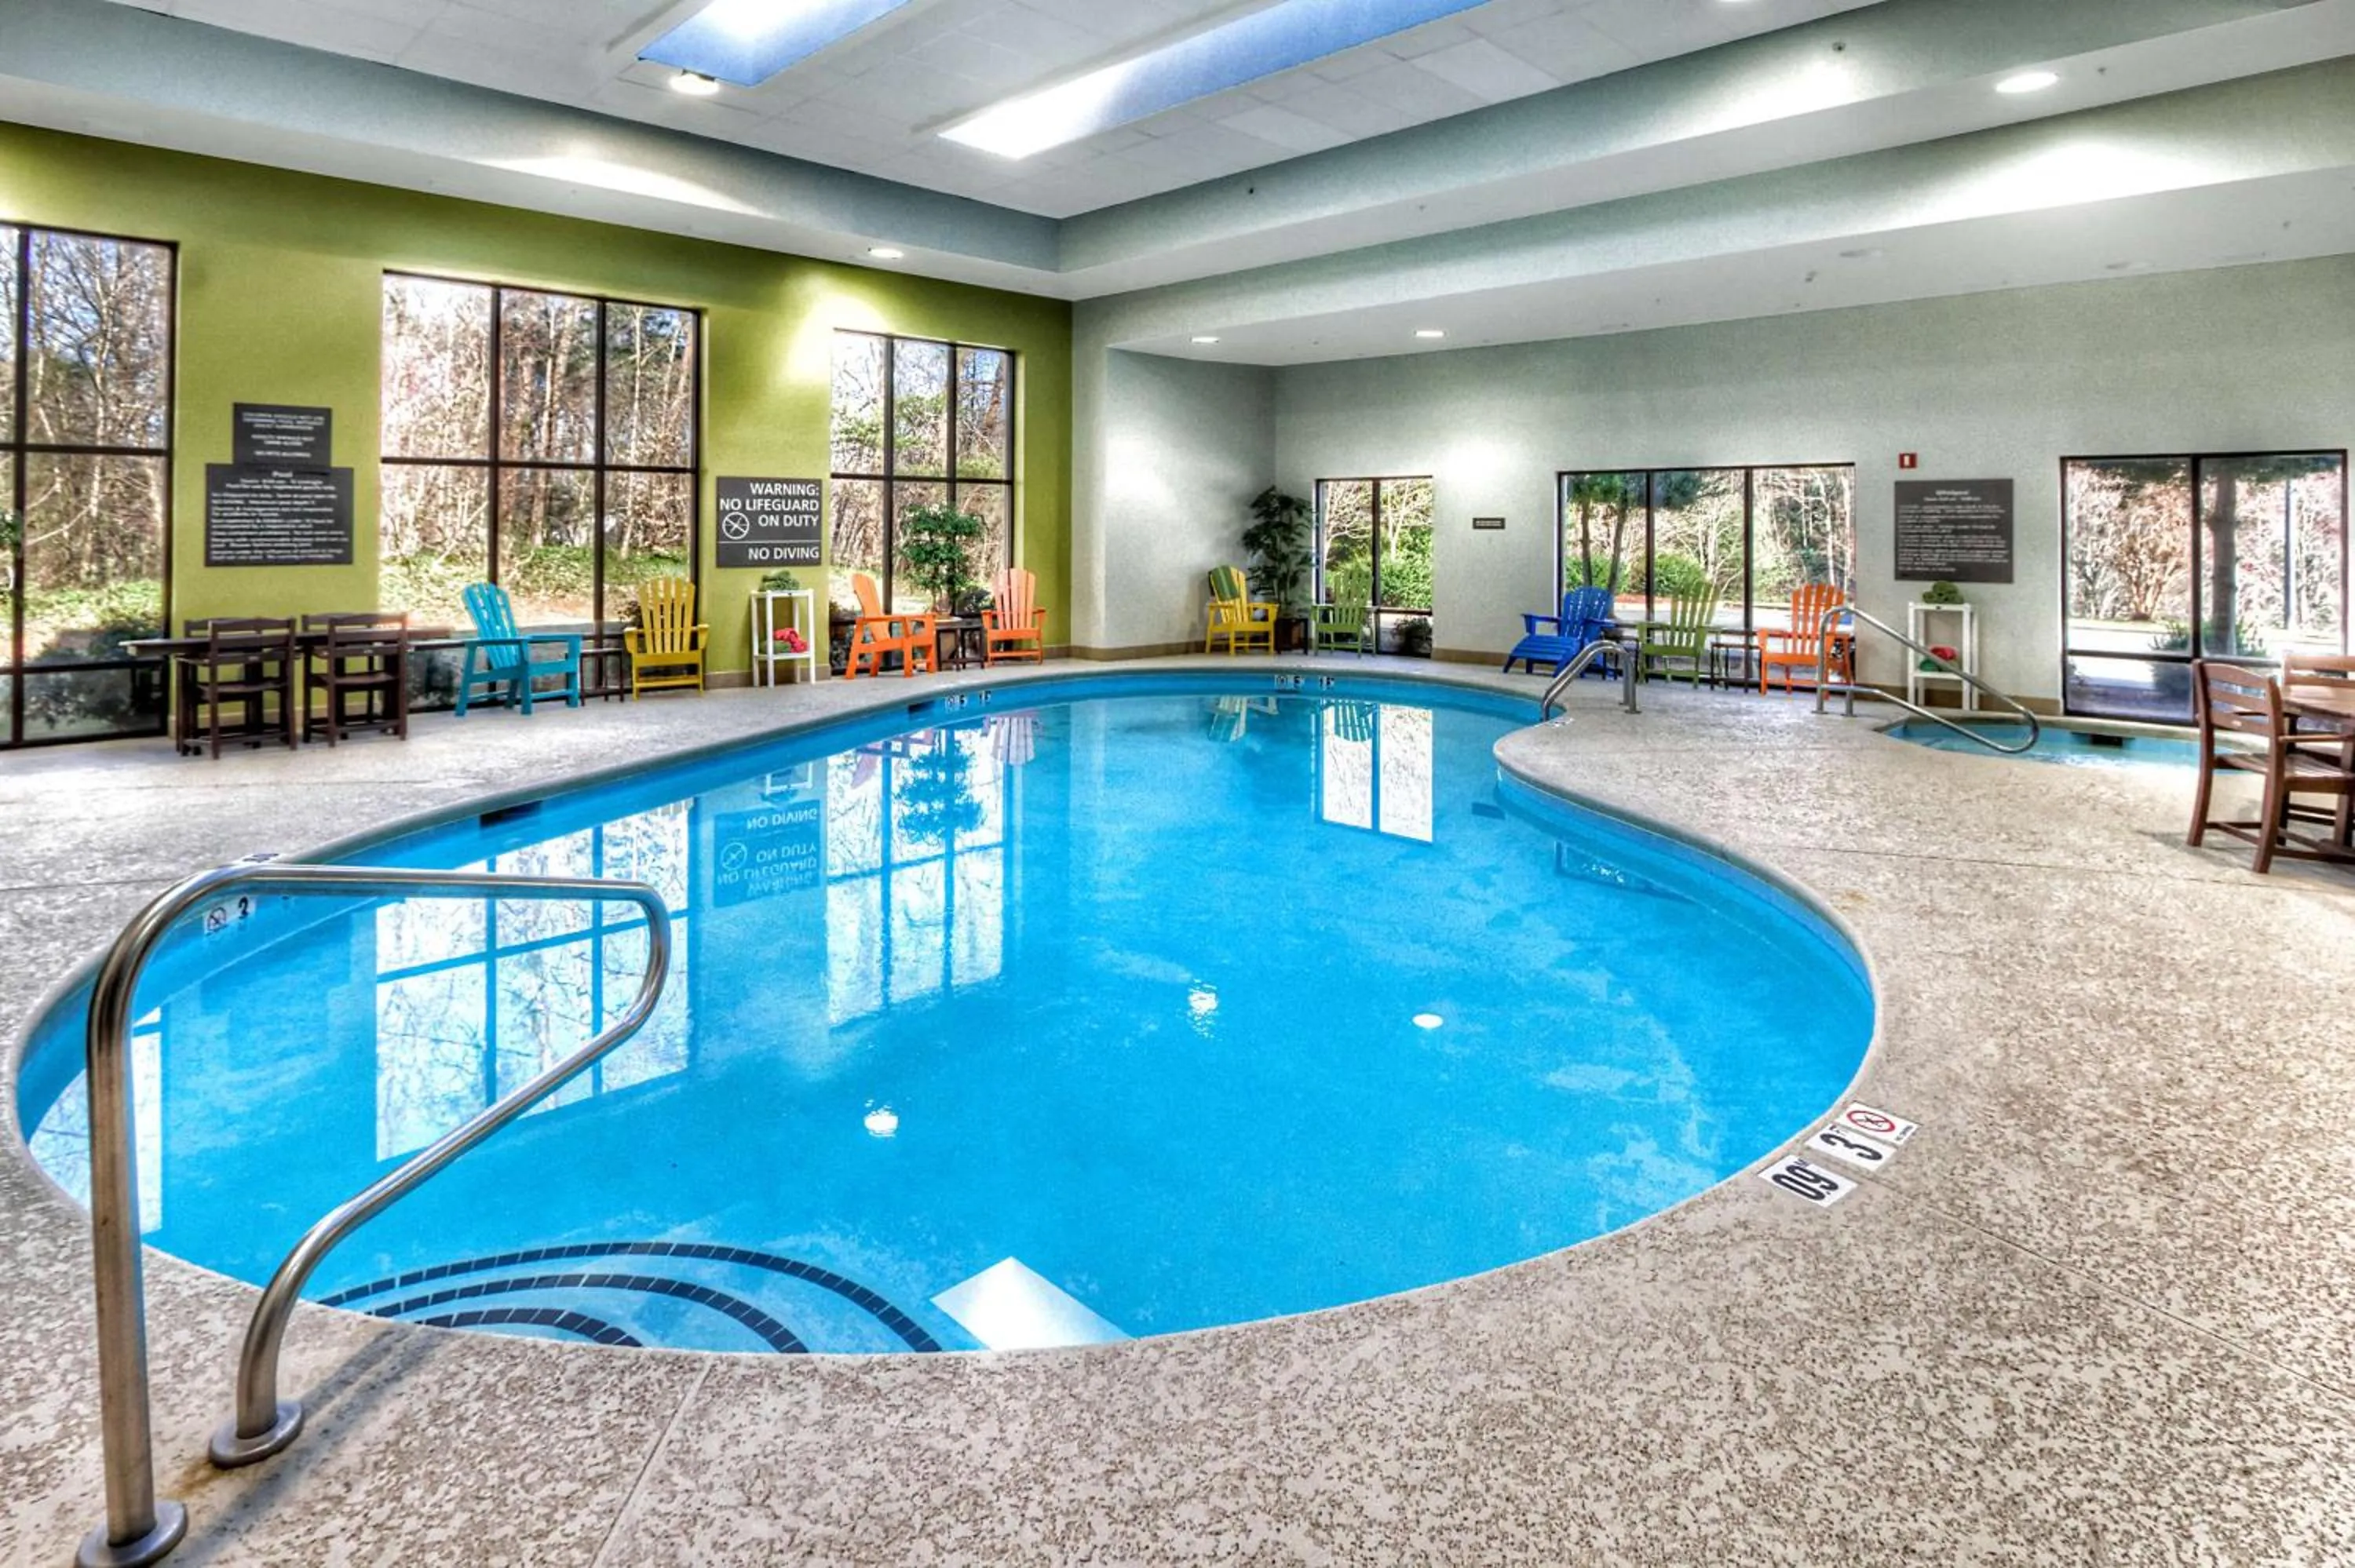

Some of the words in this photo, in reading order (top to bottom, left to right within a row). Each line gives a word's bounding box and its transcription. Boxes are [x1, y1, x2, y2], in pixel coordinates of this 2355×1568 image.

[750, 483, 820, 496] WARNING:
[720, 498, 742, 510] NO
[745, 498, 819, 511] LIFEGUARD
[758, 514, 780, 527] ON
[783, 515, 819, 527] DUTY
[748, 547, 769, 560] NO
[773, 547, 819, 560] DIVING
[1819, 1133, 1882, 1161] 3
